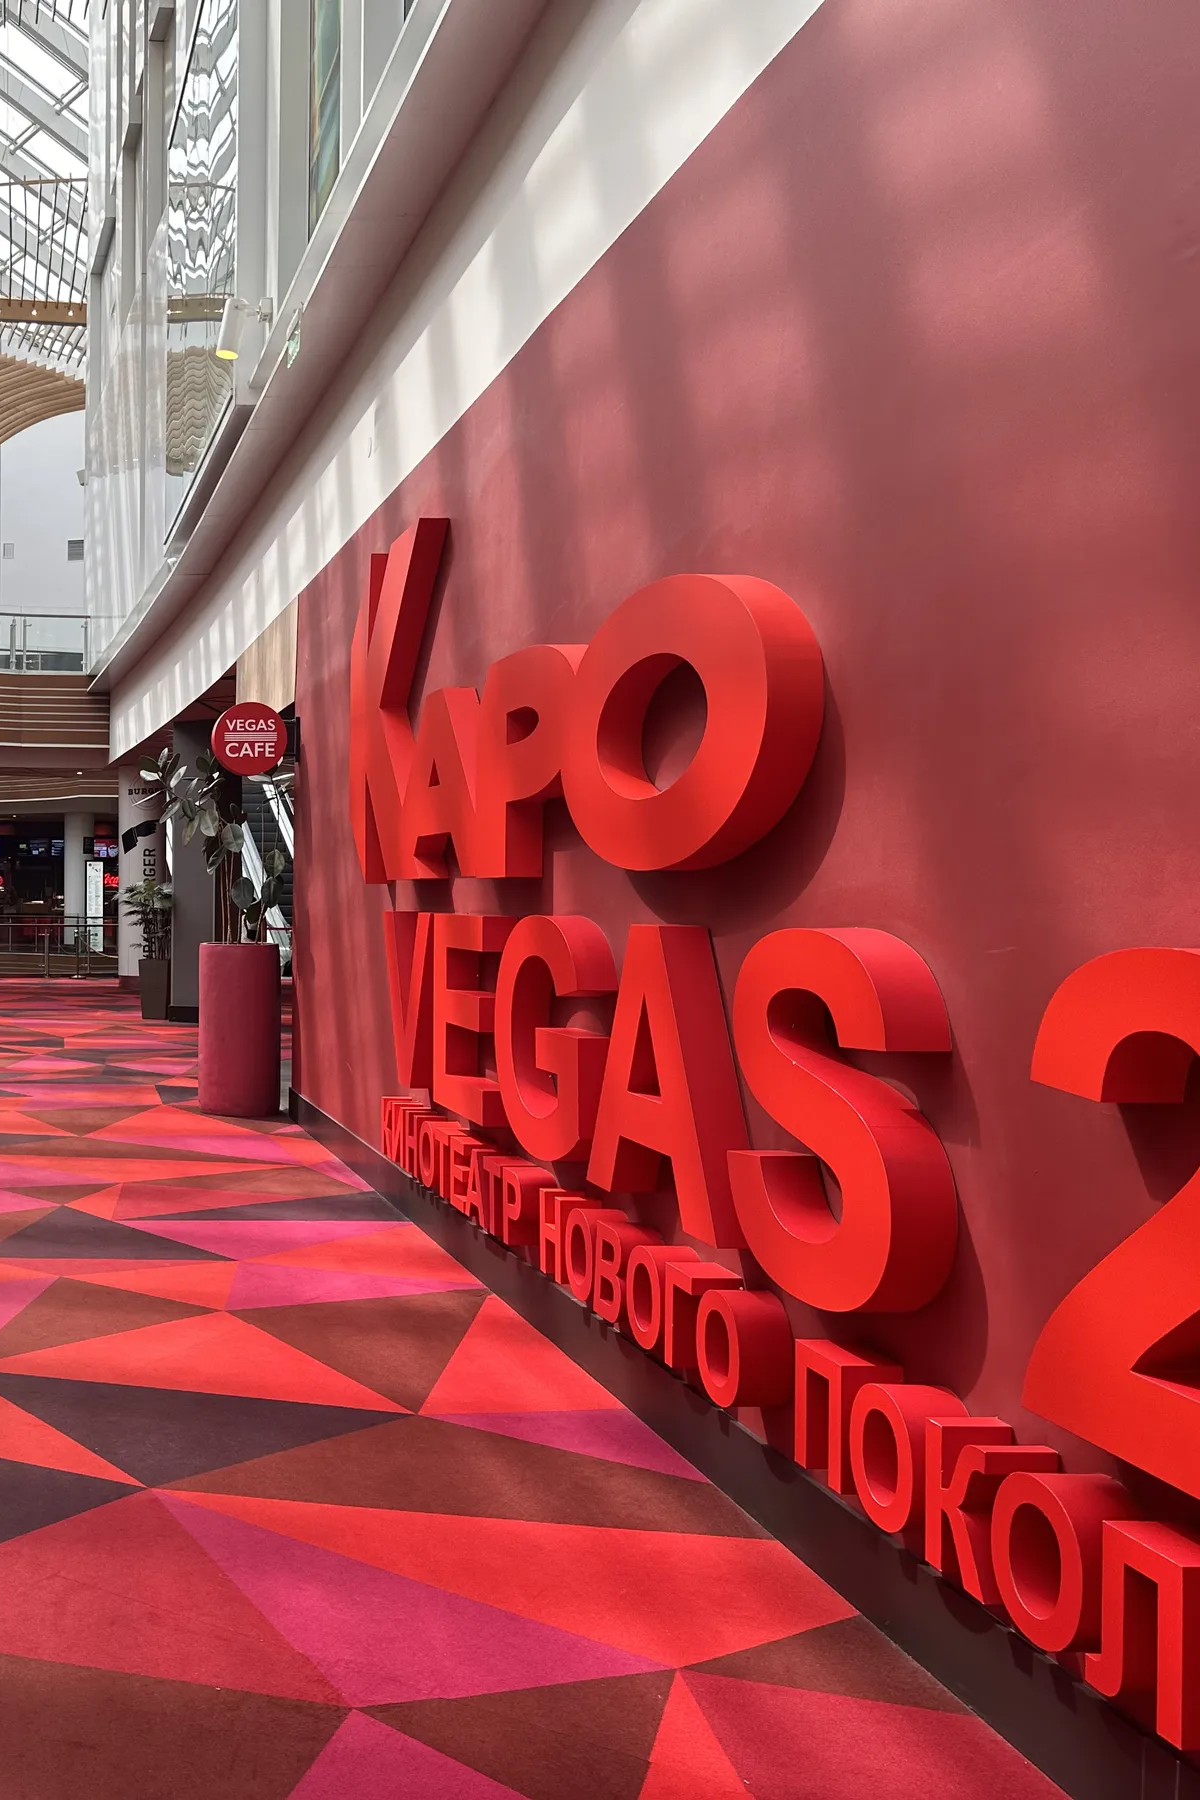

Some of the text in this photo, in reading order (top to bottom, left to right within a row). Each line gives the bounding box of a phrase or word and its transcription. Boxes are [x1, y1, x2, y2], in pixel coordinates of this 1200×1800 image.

[226, 719, 276, 731] VEGAS
[225, 742, 276, 758] CAFE
[128, 787, 165, 796] BURGE
[383, 908, 959, 1313] VEGAS
[381, 1096, 1200, 1750] КИНОТЕАТР НОВОГО ПОКОЛ
